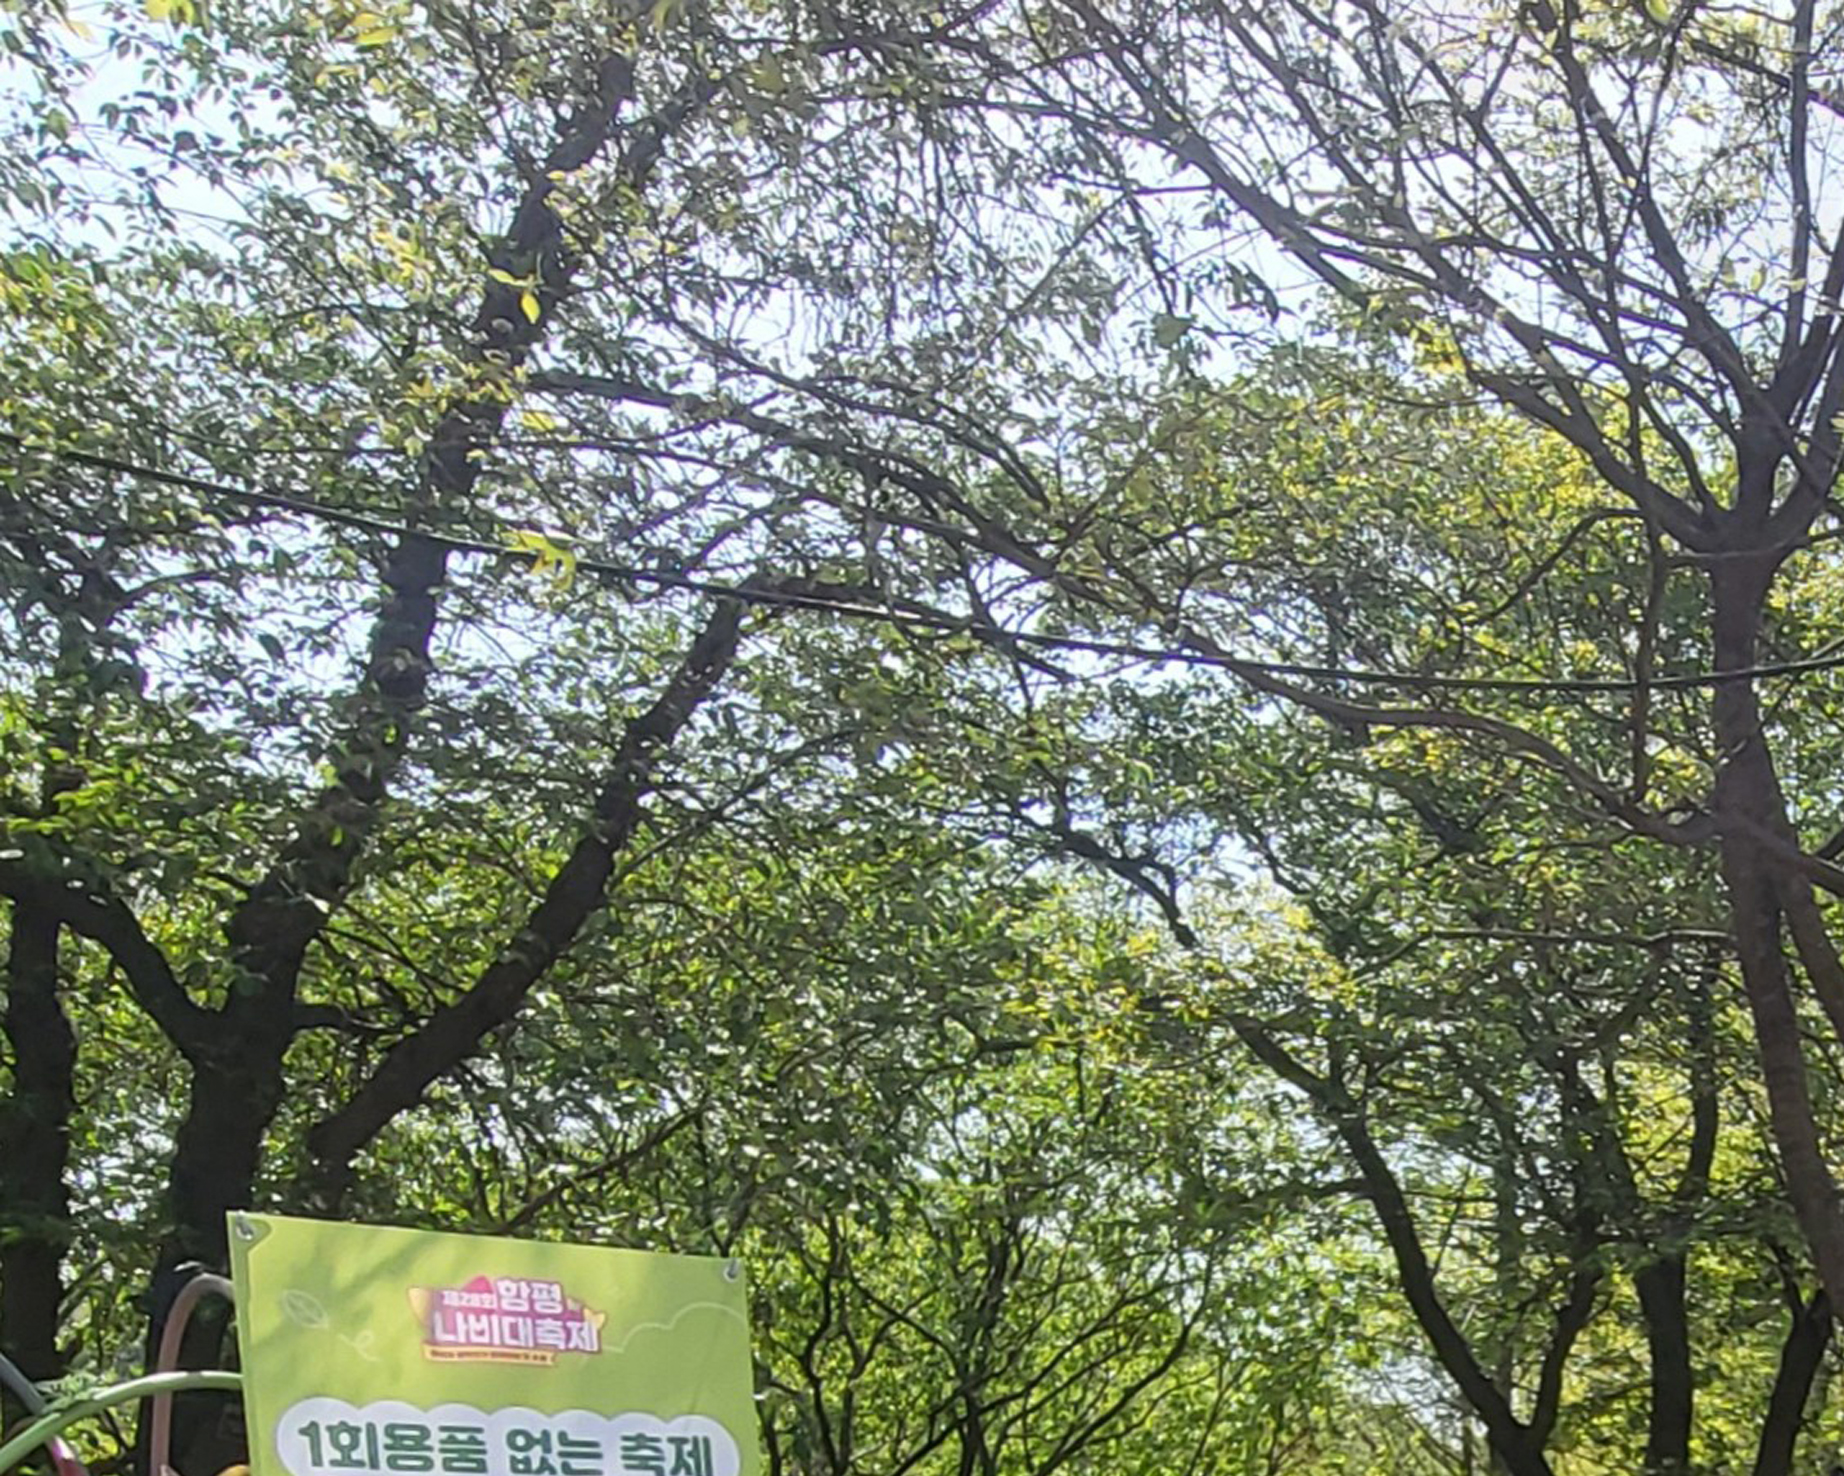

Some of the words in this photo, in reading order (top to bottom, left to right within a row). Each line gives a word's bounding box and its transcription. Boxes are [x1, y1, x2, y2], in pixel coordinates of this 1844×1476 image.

[497, 1279, 564, 1314] 함평
[433, 1310, 599, 1352] 나비대축제
[298, 1420, 488, 1475] 1회용품
[506, 1428, 604, 1476] 없는
